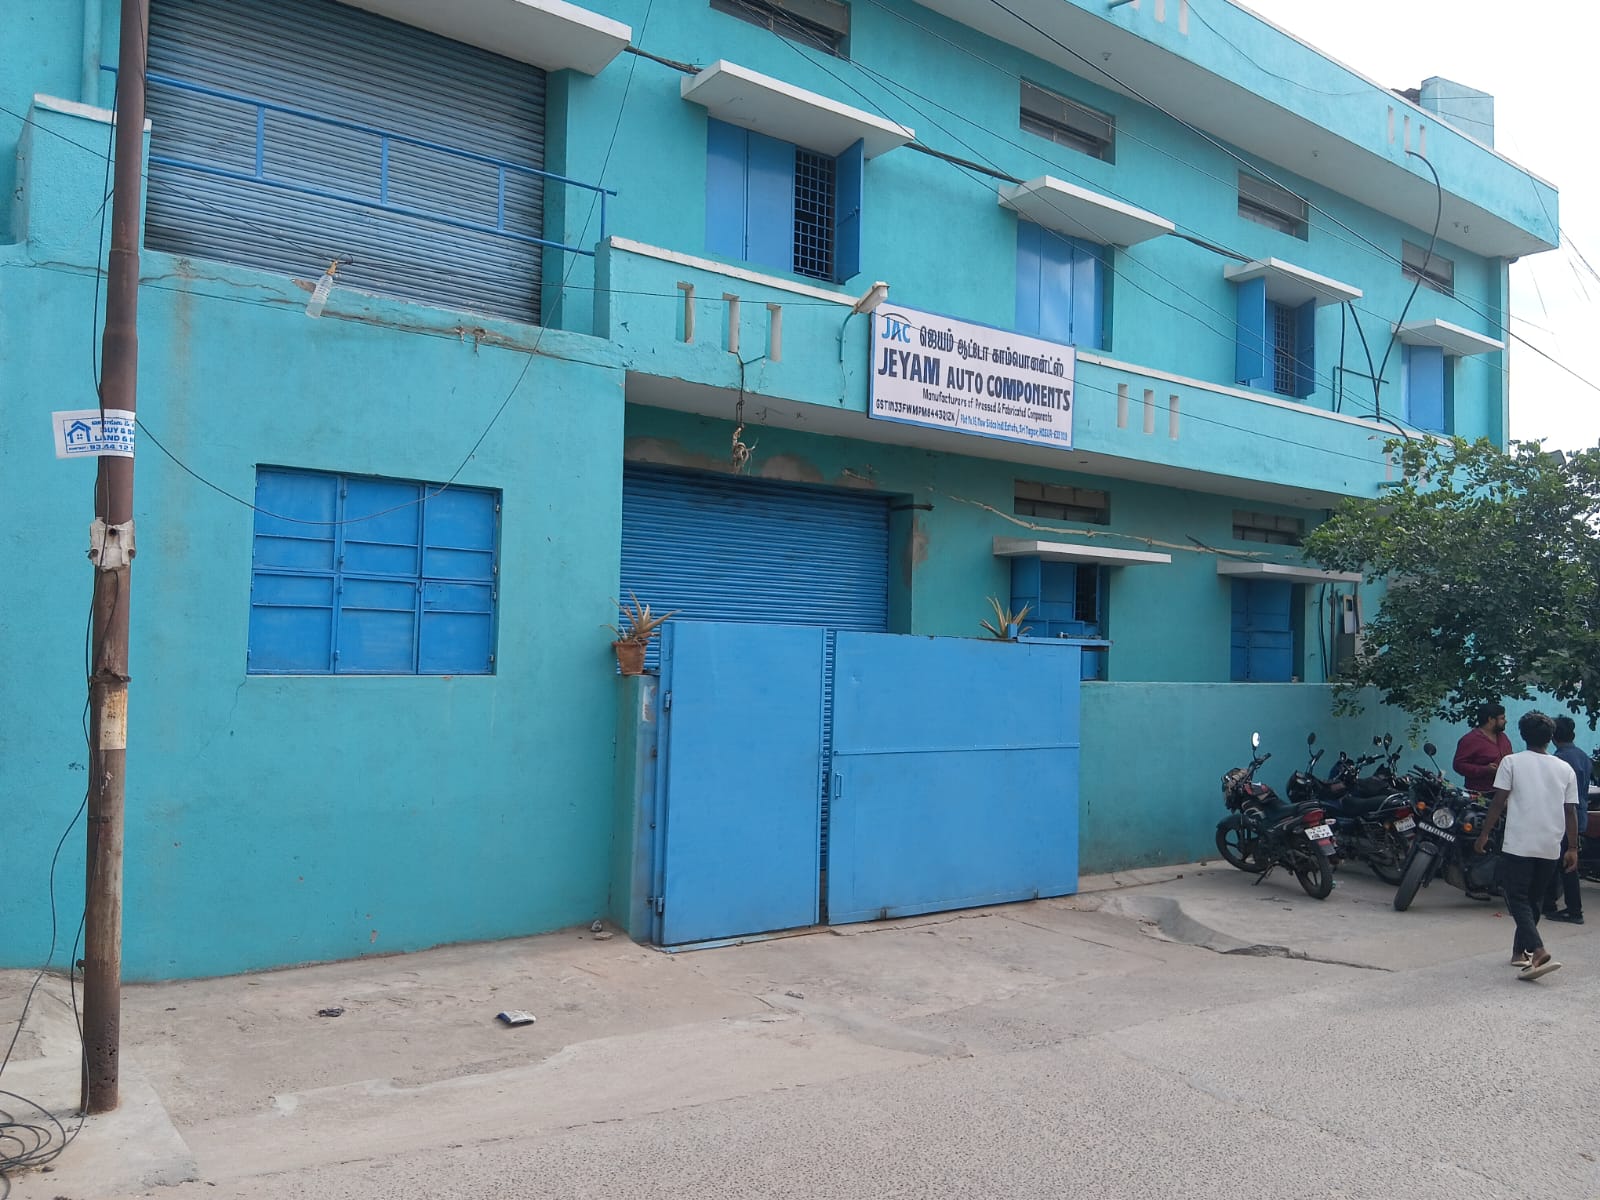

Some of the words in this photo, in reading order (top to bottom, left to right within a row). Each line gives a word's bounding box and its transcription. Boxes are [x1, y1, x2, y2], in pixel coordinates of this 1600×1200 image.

[881, 317, 911, 344] JAC
[919, 325, 954, 352] ஜெயம்
[957, 338, 990, 360] ஆட்டோ
[878, 347, 940, 386] JEYAM
[946, 365, 983, 395] AUTO
[986, 374, 1071, 412] COMPONENTS
[922, 388, 967, 407] Manufacturers
[975, 400, 997, 413] Pressed
